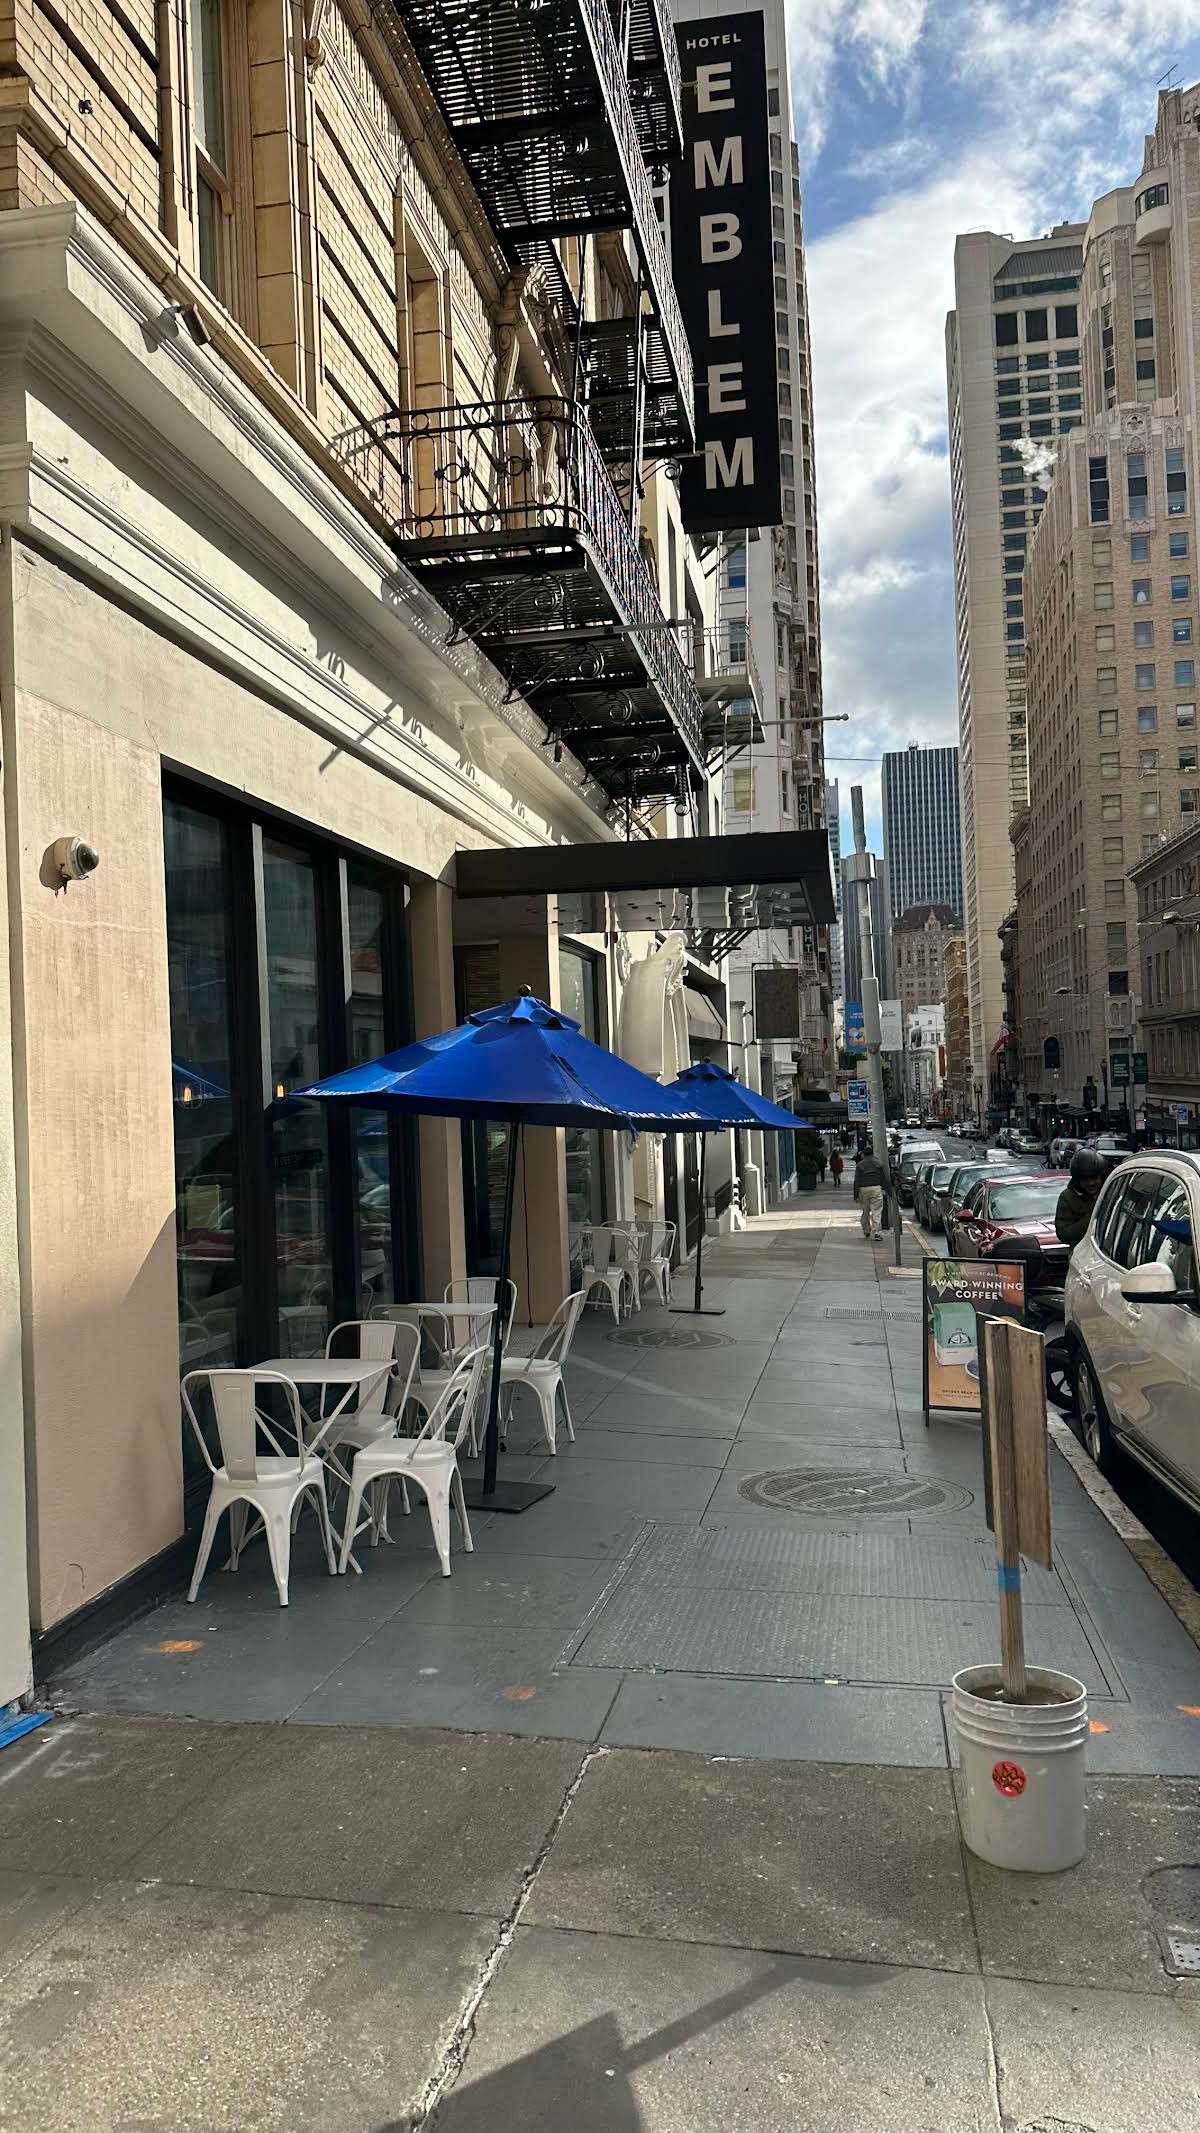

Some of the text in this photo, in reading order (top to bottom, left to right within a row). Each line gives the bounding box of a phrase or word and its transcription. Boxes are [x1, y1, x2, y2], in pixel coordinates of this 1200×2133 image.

[686, 33, 742, 50] HOTEL
[693, 61, 755, 490] EMBLEM
[660, 1111, 701, 1119] LANE
[930, 1279, 1023, 1291] AWARD-WINNING
[955, 1290, 998, 1300] COFFEE
